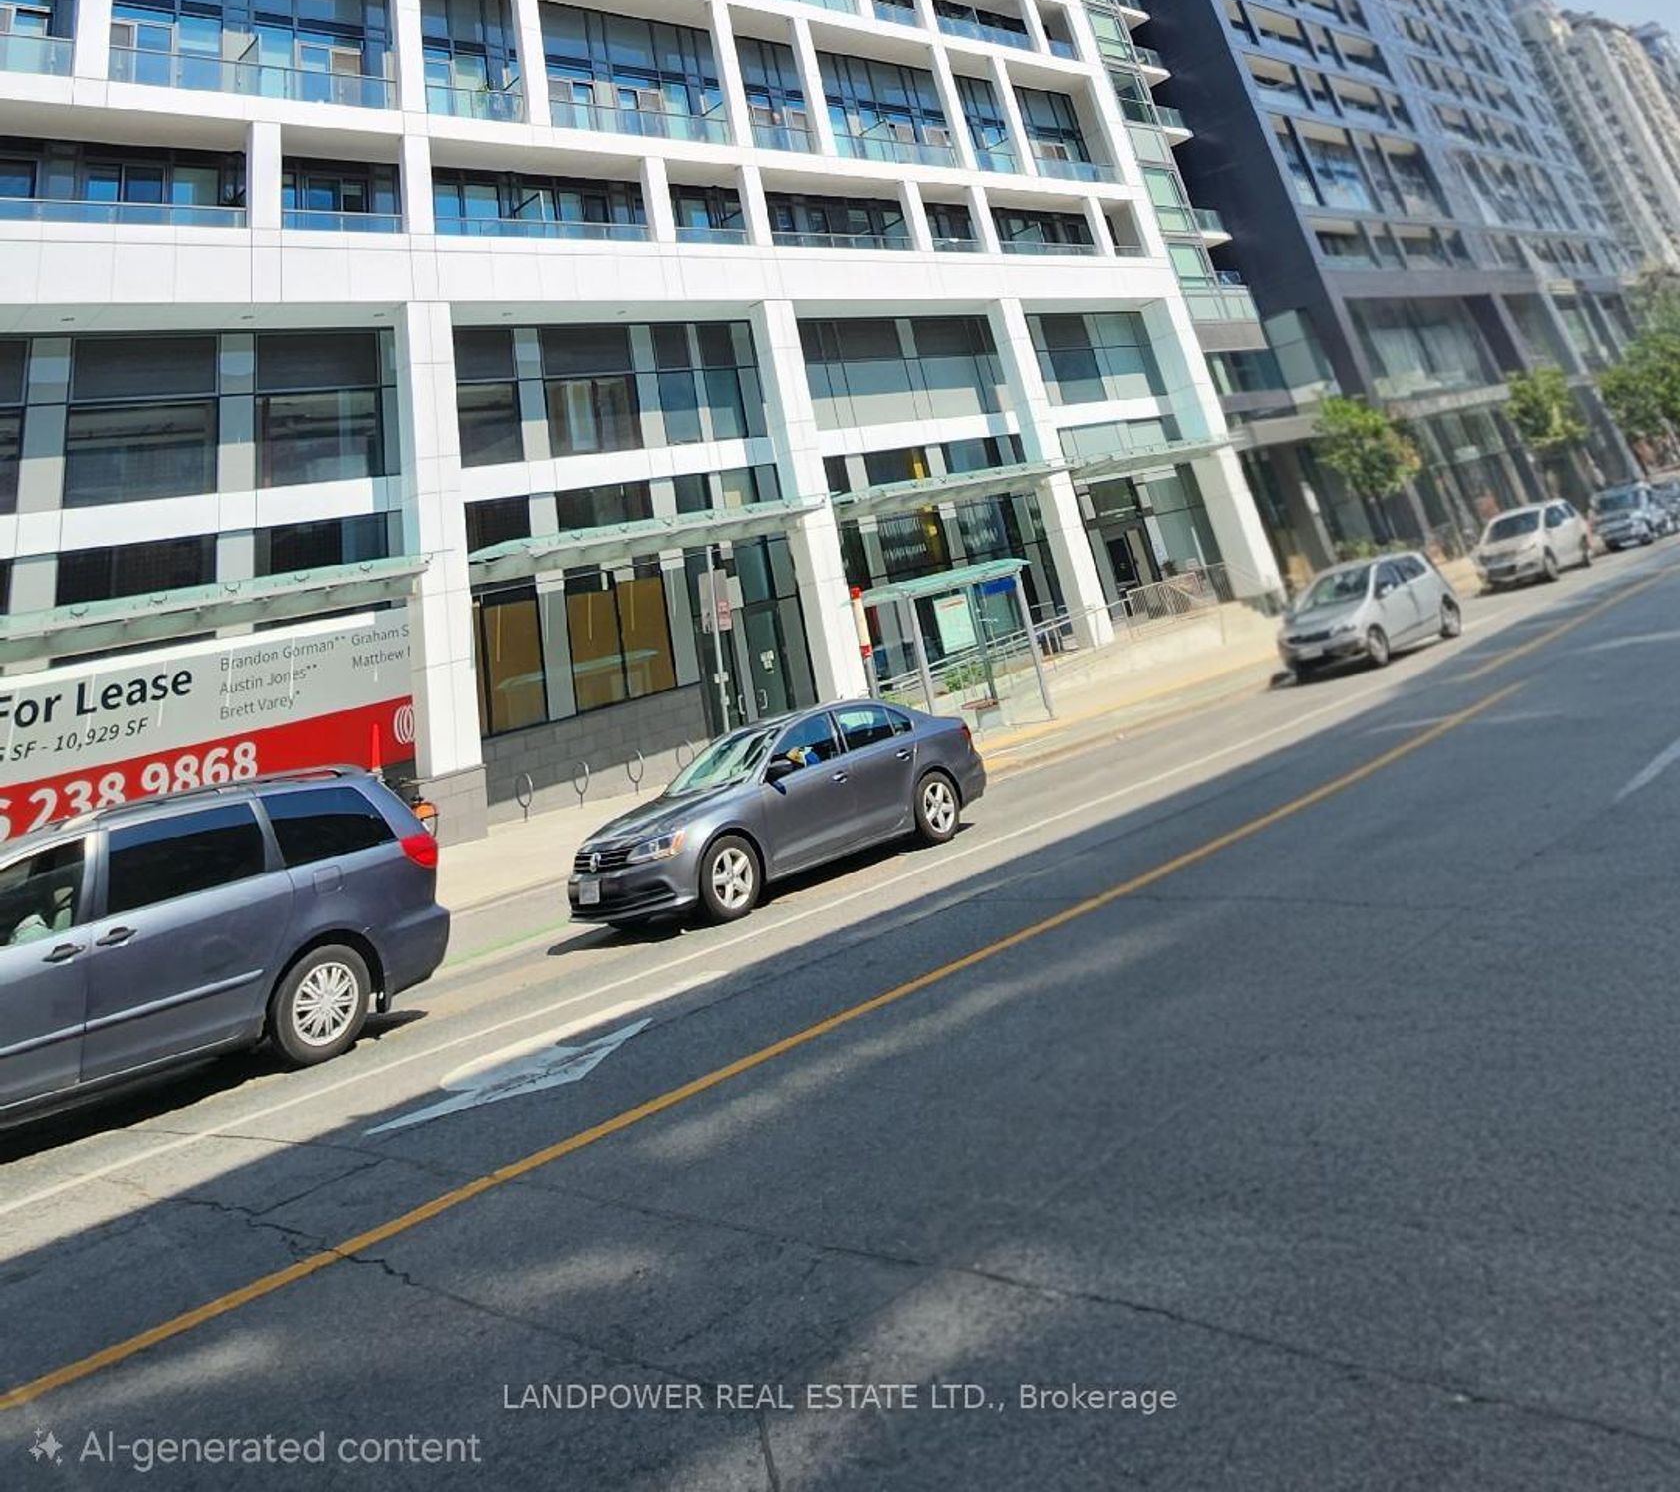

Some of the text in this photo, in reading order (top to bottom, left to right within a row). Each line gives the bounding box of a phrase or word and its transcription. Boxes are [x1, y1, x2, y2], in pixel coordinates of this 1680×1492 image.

[351, 629, 399, 646] Graham
[220, 651, 279, 672] Brandon
[352, 650, 404, 669] Matthew
[76, 670, 192, 716] Lease
[219, 676, 263, 696] Austin
[220, 702, 256, 720] Brett
[10, 740, 37, 761] SF
[54, 723, 120, 752] 10,929
[125, 717, 148, 737] SF
[28, 772, 126, 834] 238
[140, 742, 258, 794] 9868
